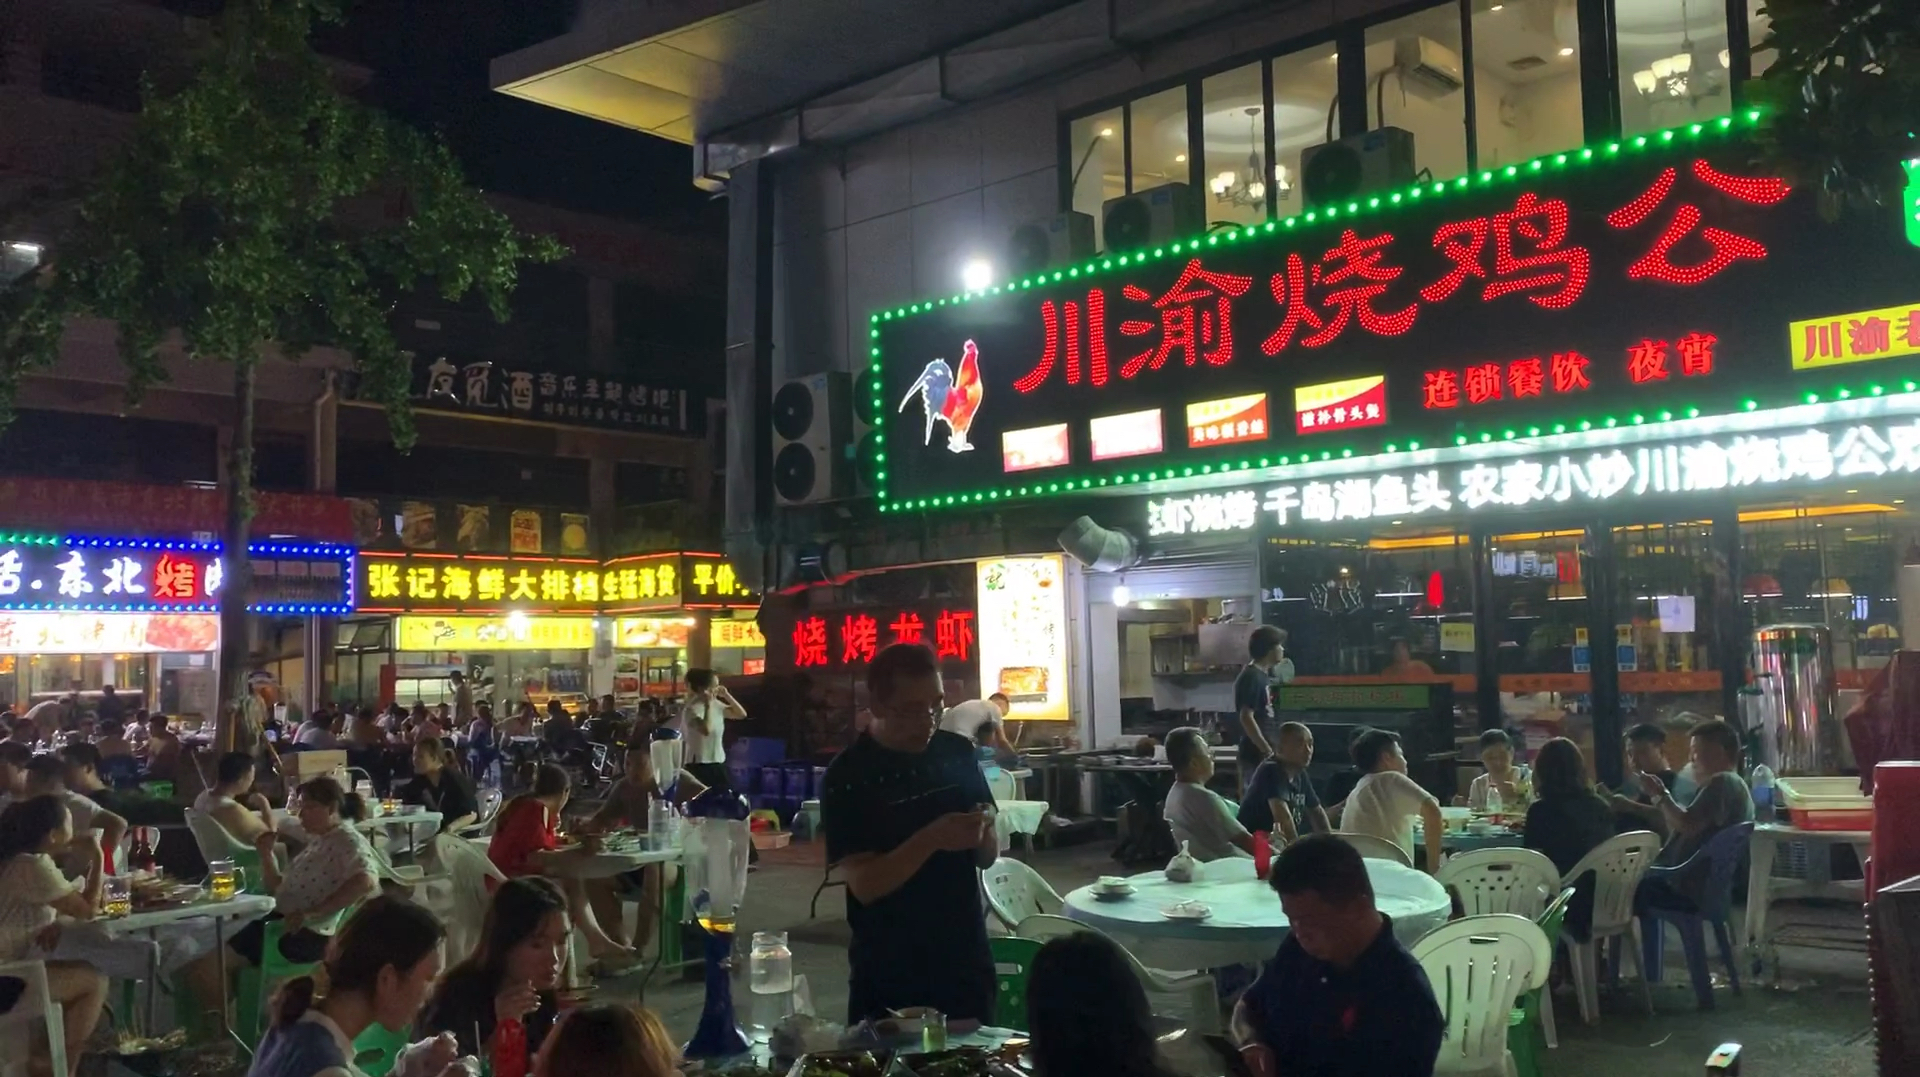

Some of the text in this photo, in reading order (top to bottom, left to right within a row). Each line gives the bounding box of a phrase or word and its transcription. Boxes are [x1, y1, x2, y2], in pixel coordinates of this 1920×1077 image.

[1013, 158, 1793, 394] 川渝烧鸡公
[1422, 331, 1718, 409] 连锁餐饮 夜宵
[1263, 470, 1453, 526] 千岛湖鱼头
[368, 563, 599, 602] 张记海鲜大排档
[693, 563, 749, 597] 平价
